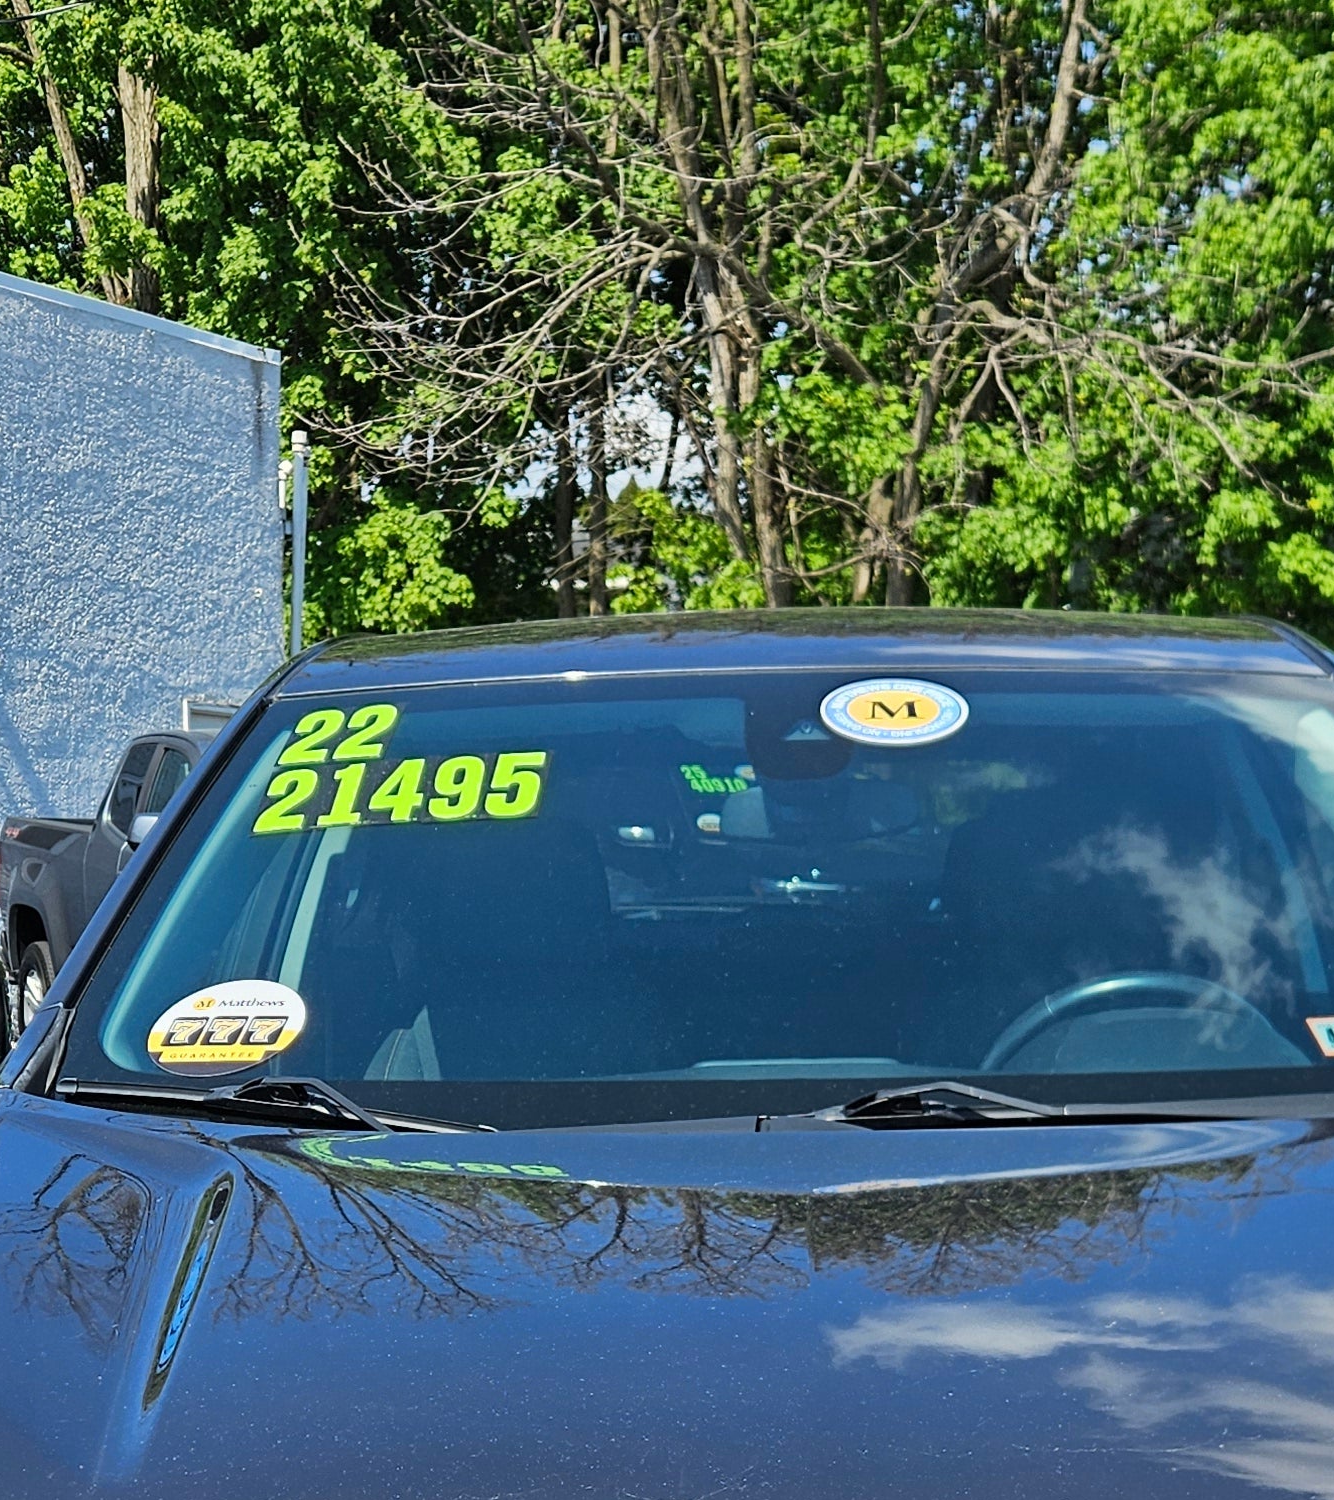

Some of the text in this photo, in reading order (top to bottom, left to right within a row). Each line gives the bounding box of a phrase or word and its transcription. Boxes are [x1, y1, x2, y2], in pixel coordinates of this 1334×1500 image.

[865, 699, 926, 721] M
[277, 703, 399, 765] 22
[252, 751, 547, 833] 21495
[218, 997, 286, 1008] Matthews
